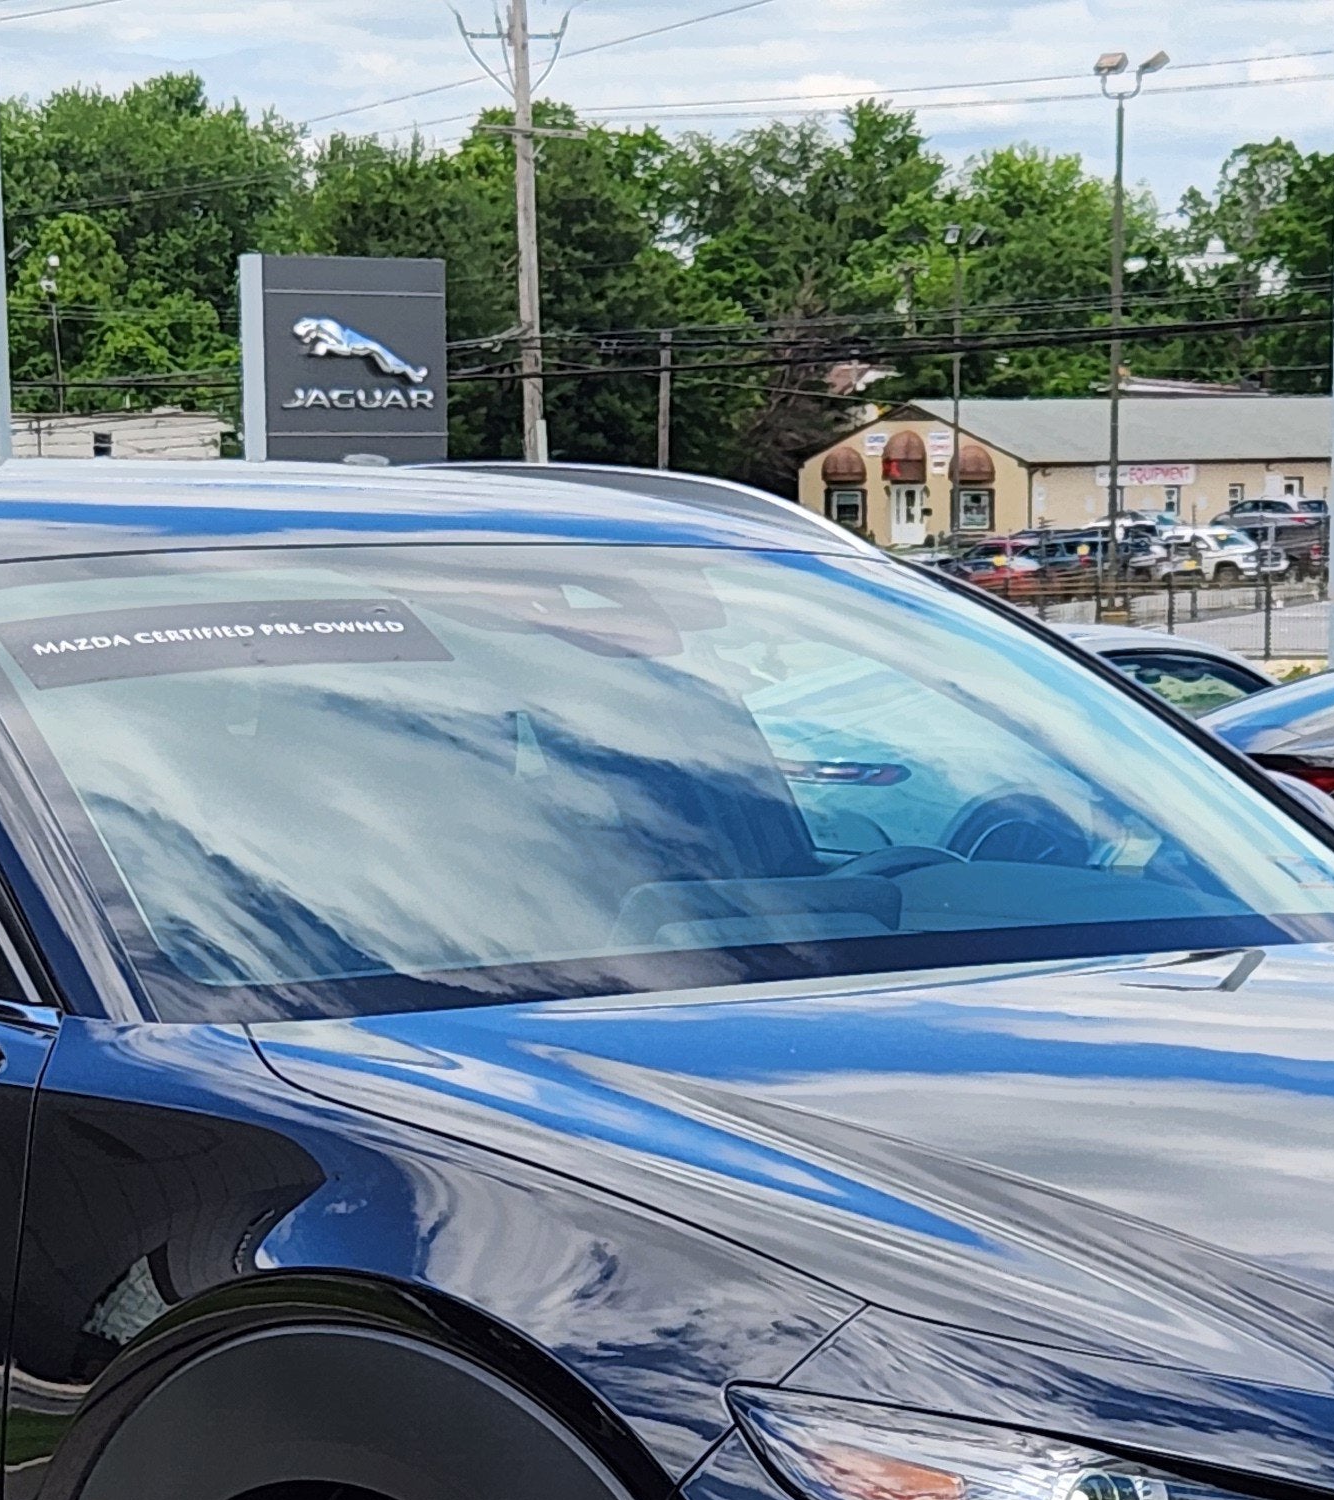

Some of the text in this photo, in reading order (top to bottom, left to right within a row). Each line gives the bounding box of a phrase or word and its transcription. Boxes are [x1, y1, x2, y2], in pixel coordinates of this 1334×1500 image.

[281, 387, 434, 410] JAGUAR
[32, 620, 405, 656] MAZDA CERTIFIED PRE-OWNED
